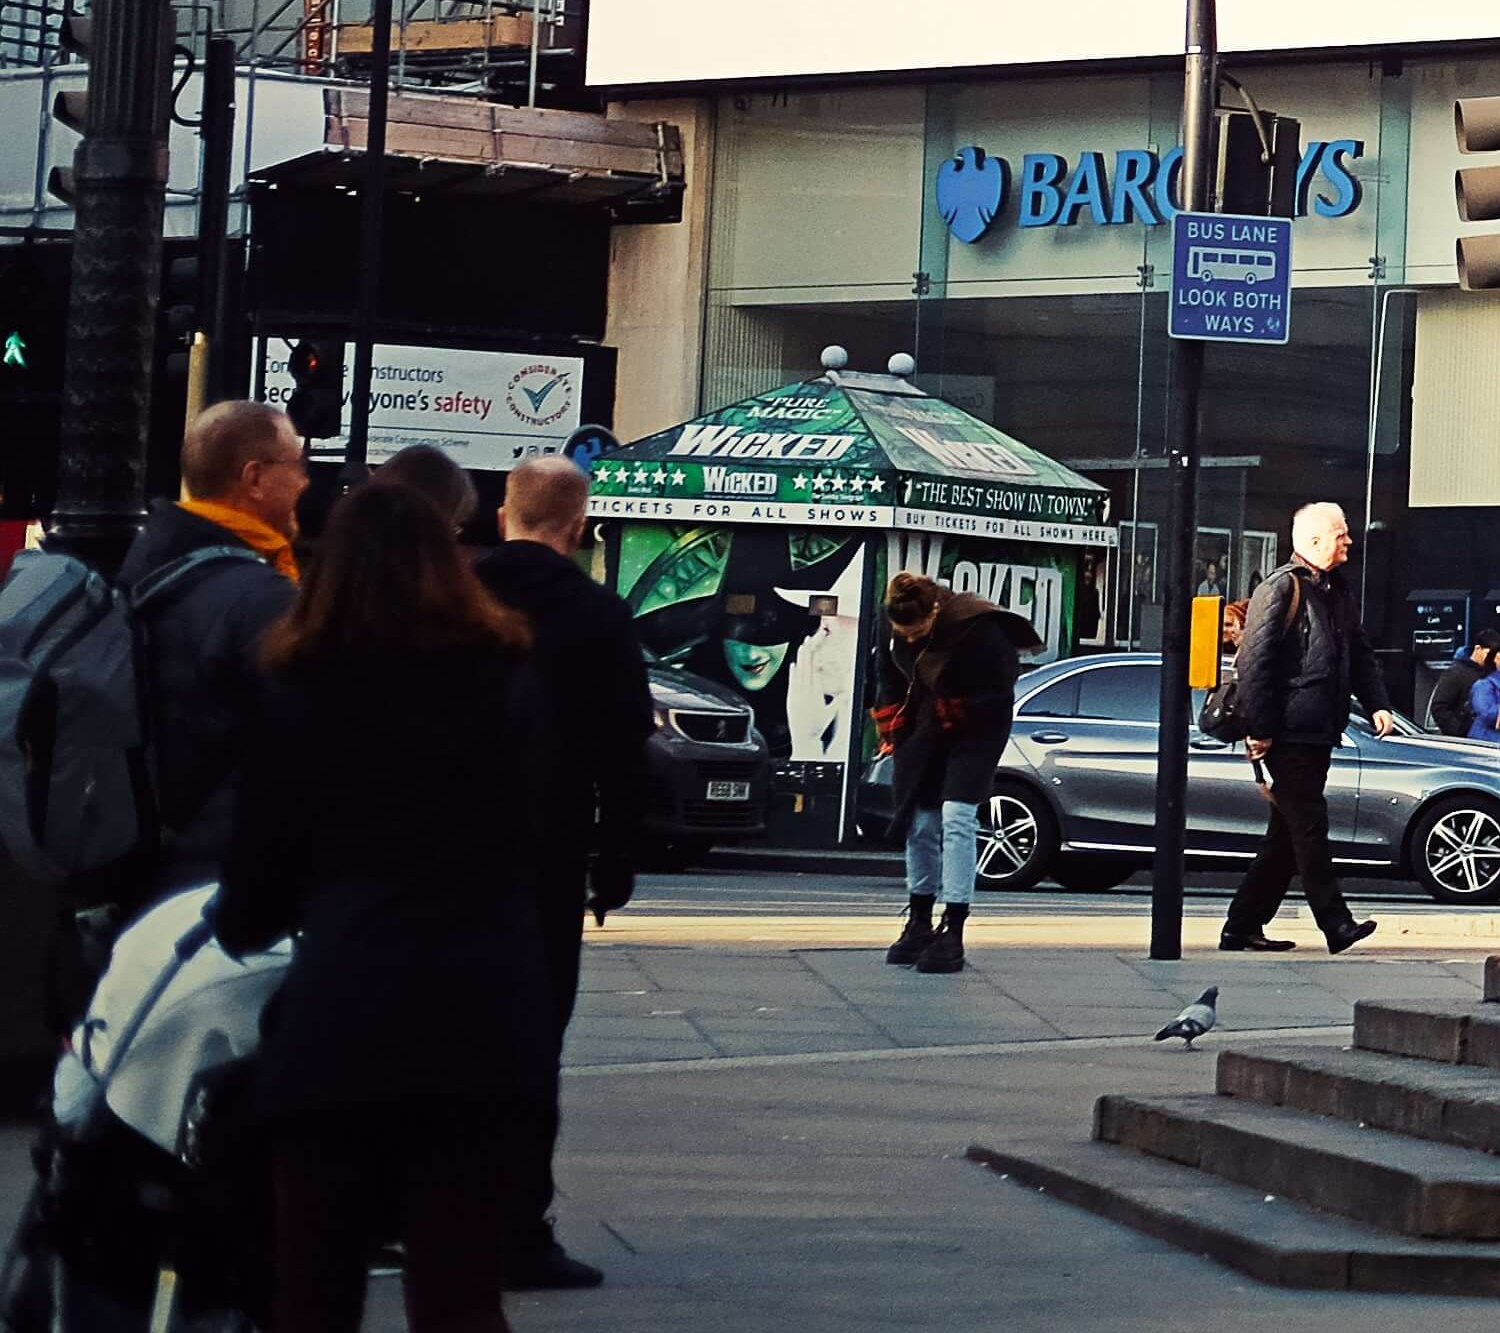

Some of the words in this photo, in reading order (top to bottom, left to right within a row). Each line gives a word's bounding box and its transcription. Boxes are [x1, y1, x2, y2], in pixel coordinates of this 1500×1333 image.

[1187, 222, 1225, 240] BUS
[1231, 225, 1278, 243] LANE
[1178, 289, 1227, 307] LOOK
[1233, 292, 1281, 310] BOTH
[1204, 314, 1255, 333] WAYS
[371, 364, 444, 384] nstructors
[433, 390, 492, 419] safety
[951, 485, 983, 507] BEST
[985, 490, 1028, 512] SHOW
[1028, 493, 1044, 514] IN
[591, 500, 674, 515] TICKETS
[693, 503, 732, 517] FOR
[751, 506, 788, 520] ALL
[807, 508, 878, 522] SHOWS
[906, 512, 925, 525] BUY
[935, 515, 977, 531] TICKETS
[986, 520, 1005, 534] FOR
[1014, 524, 1032, 537] ALL
[1040, 526, 1074, 540] SHOWS
[1082, 530, 1106, 542] HERE
